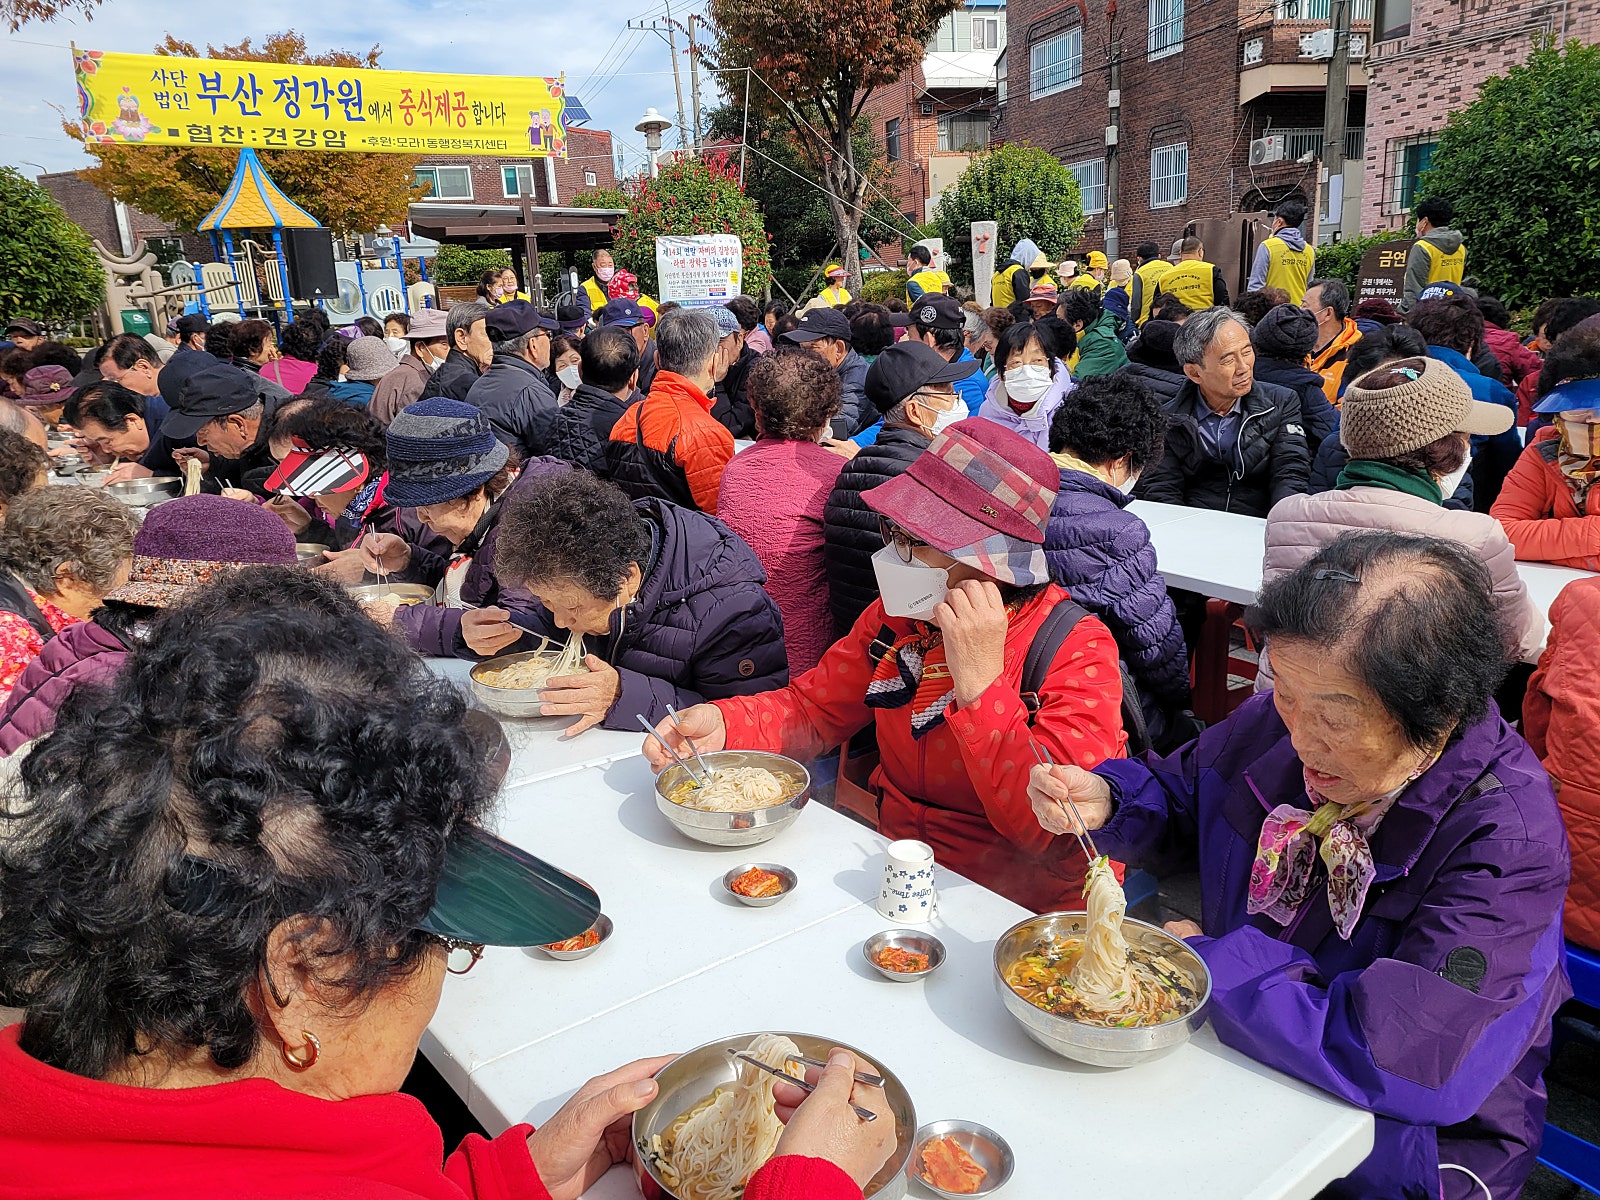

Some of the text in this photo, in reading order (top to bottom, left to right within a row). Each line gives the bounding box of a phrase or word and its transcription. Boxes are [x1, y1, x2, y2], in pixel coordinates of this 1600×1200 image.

[150, 68, 188, 88] 사단
[153, 90, 190, 110] 법인
[196, 71, 264, 117] 부산
[663, 247, 682, 258] 제14회
[684, 246, 696, 257] 연말
[1379, 249, 1407, 268] 금연
